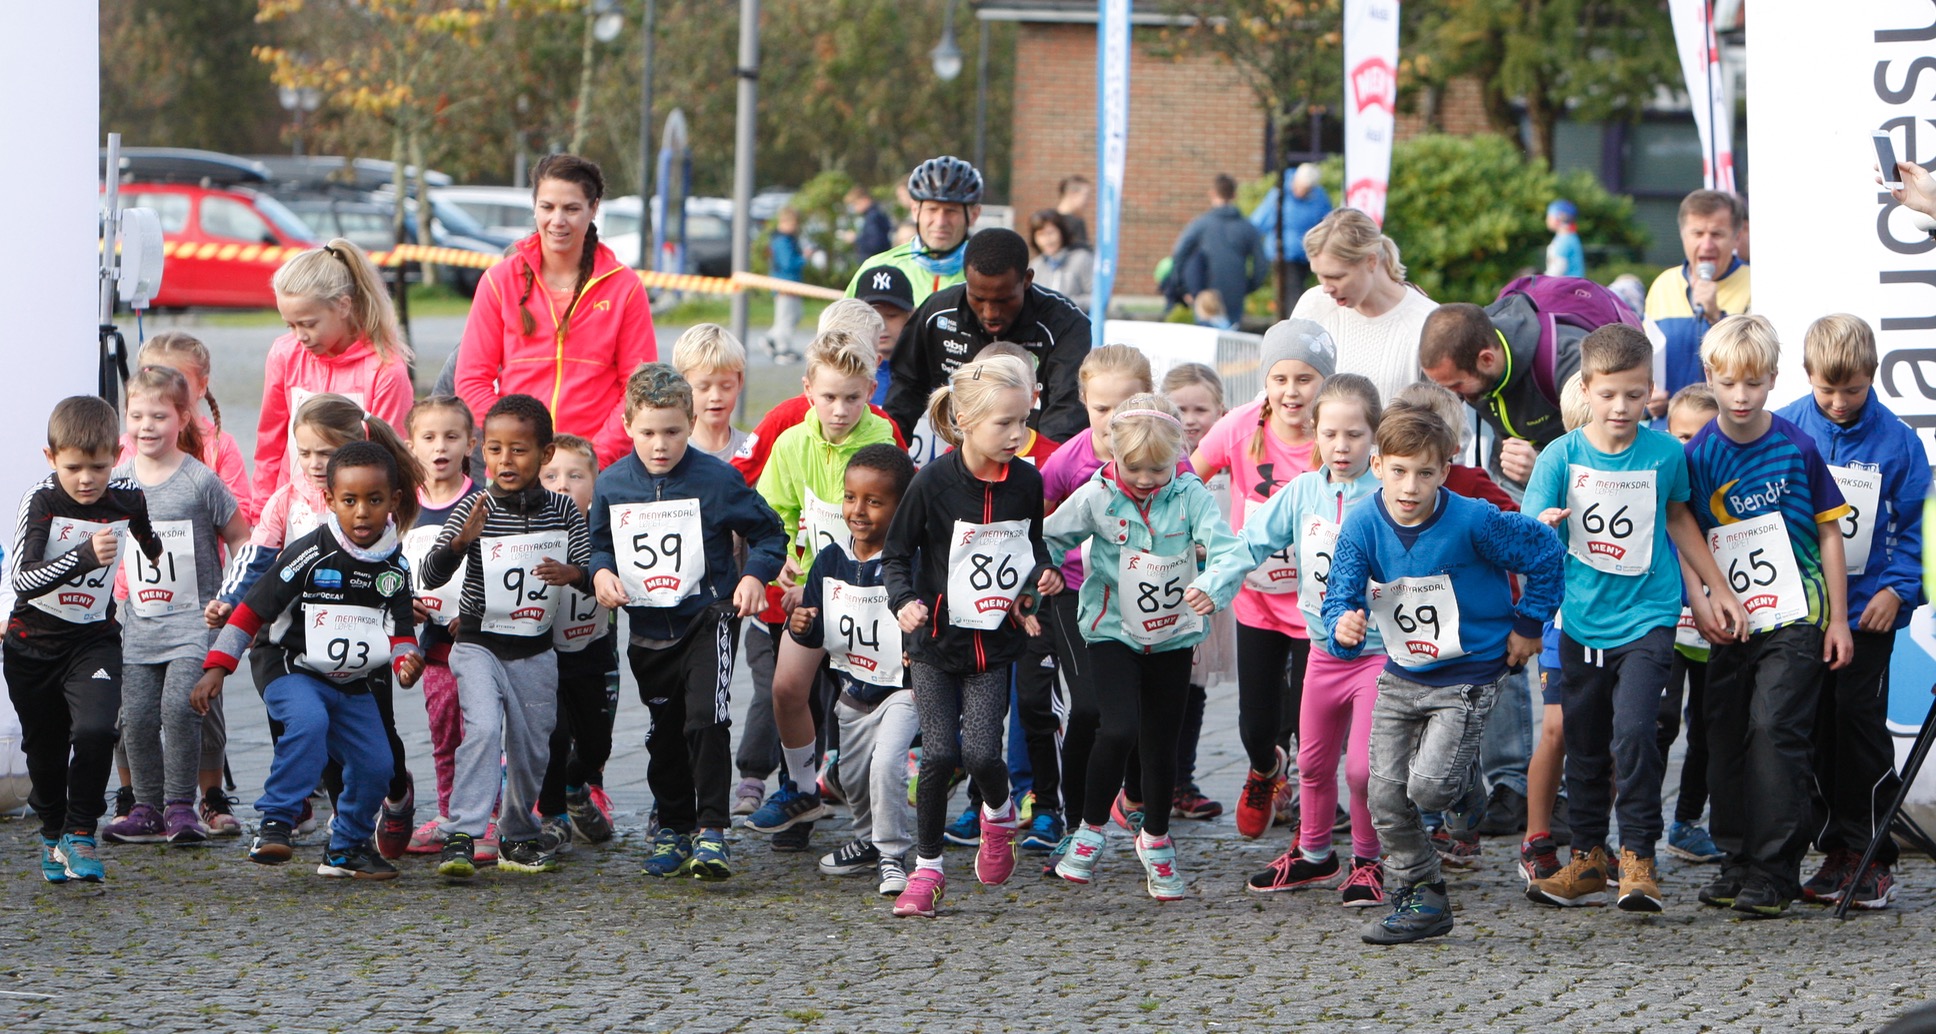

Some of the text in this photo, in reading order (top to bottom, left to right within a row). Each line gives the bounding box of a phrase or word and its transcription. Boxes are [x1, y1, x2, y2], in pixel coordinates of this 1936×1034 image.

[1596, 480, 1651, 489] MENYAKSDAL
[1730, 478, 1791, 514] Bendit
[639, 510, 694, 520] MENYAKSDAL
[1582, 502, 1633, 539] 66
[1726, 522, 1779, 543] MENYAKSDAL
[632, 533, 682, 573] 59
[1591, 543, 1622, 556] MENY
[970, 553, 1018, 591] 86
[1728, 547, 1777, 594] 65
[503, 567, 548, 607] 92
[647, 578, 677, 588] MENY
[1391, 583, 1446, 593] MENYAKSDAL
[62, 595, 93, 606] MENY
[141, 591, 170, 600] MENY
[1137, 576, 1185, 614] 85
[422, 599, 439, 608] ENY
[979, 600, 1010, 609] MENY
[1746, 596, 1774, 610] MENY
[514, 609, 542, 618] MENY
[334, 615, 378, 626] MENYAKSDAL
[1148, 618, 1177, 629] MENY
[1393, 603, 1440, 640] 69
[568, 625, 593, 637] MENY
[840, 614, 879, 652] 94
[327, 638, 369, 671] 93
[1409, 643, 1436, 655] MENY
[849, 656, 874, 668] MENY
